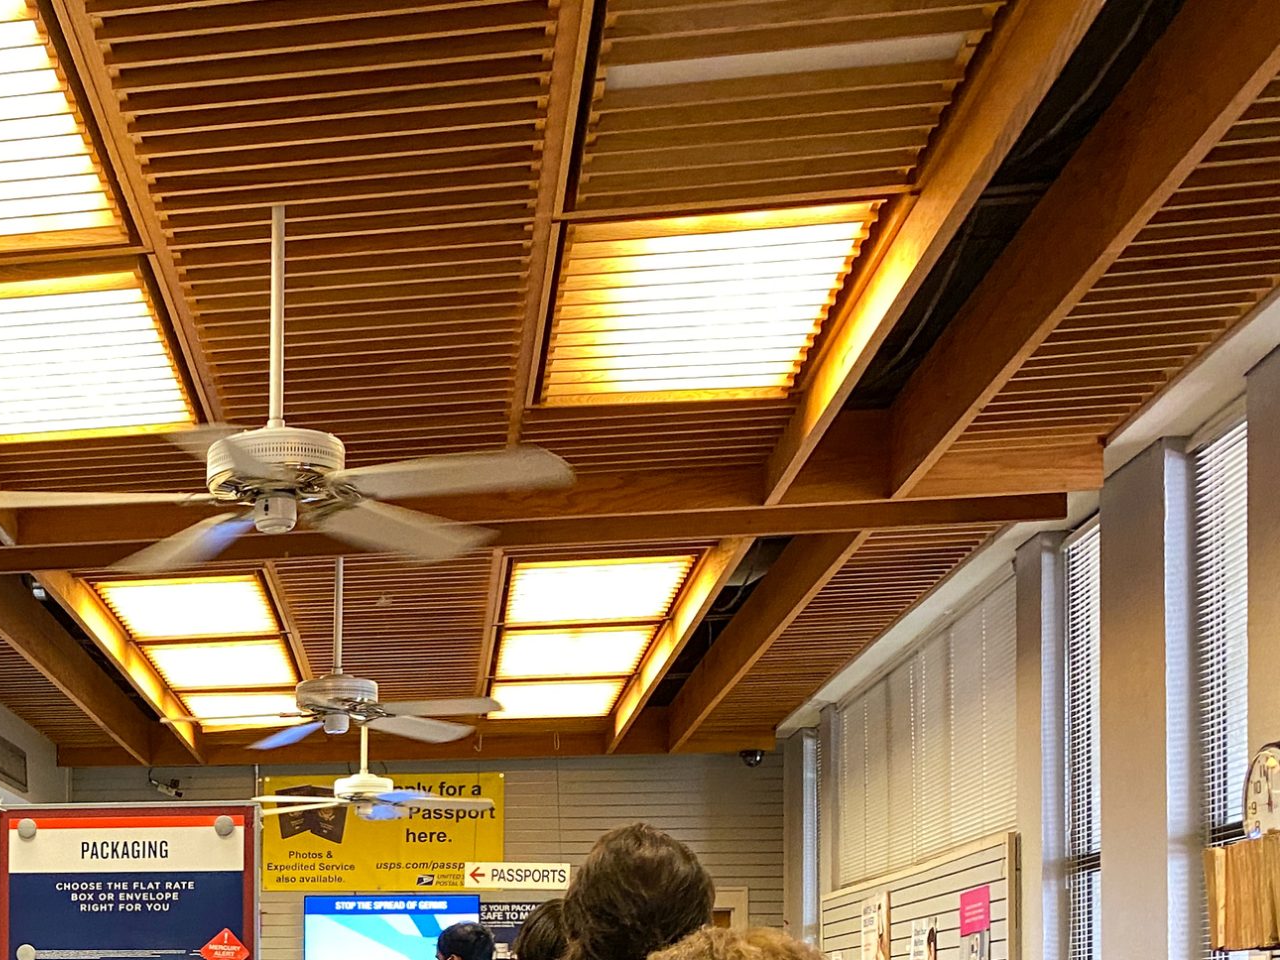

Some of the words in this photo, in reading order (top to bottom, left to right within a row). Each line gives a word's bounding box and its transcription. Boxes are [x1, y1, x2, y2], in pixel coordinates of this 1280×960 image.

[439, 782, 465, 796] for
[471, 785, 482, 796] a
[1253, 781, 1261, 794] 10
[1251, 801, 1257, 815] 9
[409, 806, 496, 822] Passport
[406, 829, 452, 843] here.
[81, 840, 169, 859] PACKAGING
[289, 850, 323, 859] Photos
[326, 850, 333, 859] &
[267, 862, 316, 872] Expedited
[319, 862, 356, 871] Service
[376, 861, 465, 871] usps.com/passp
[299, 875, 346, 883] available.
[491, 868, 567, 883] PASSPORTS
[55, 882, 103, 891] CHOOSE
[107, 882, 128, 890] THE
[133, 881, 161, 890] FLAT
[165, 881, 195, 890] RATE
[71, 892, 94, 901] BOX
[98, 892, 115, 900] OR
[119, 892, 179, 901] ENVELOPE
[80, 903, 114, 912] RIGHT
[119, 903, 142, 911] FOR
[146, 903, 170, 911] YOU
[335, 901, 356, 910] STOP
[357, 901, 373, 909] THE
[373, 901, 405, 910] SPREAD
[406, 901, 418, 909] OF
[418, 901, 448, 910] GERMS
[481, 912, 503, 920] SAFE
[505, 912, 518, 920] TO
